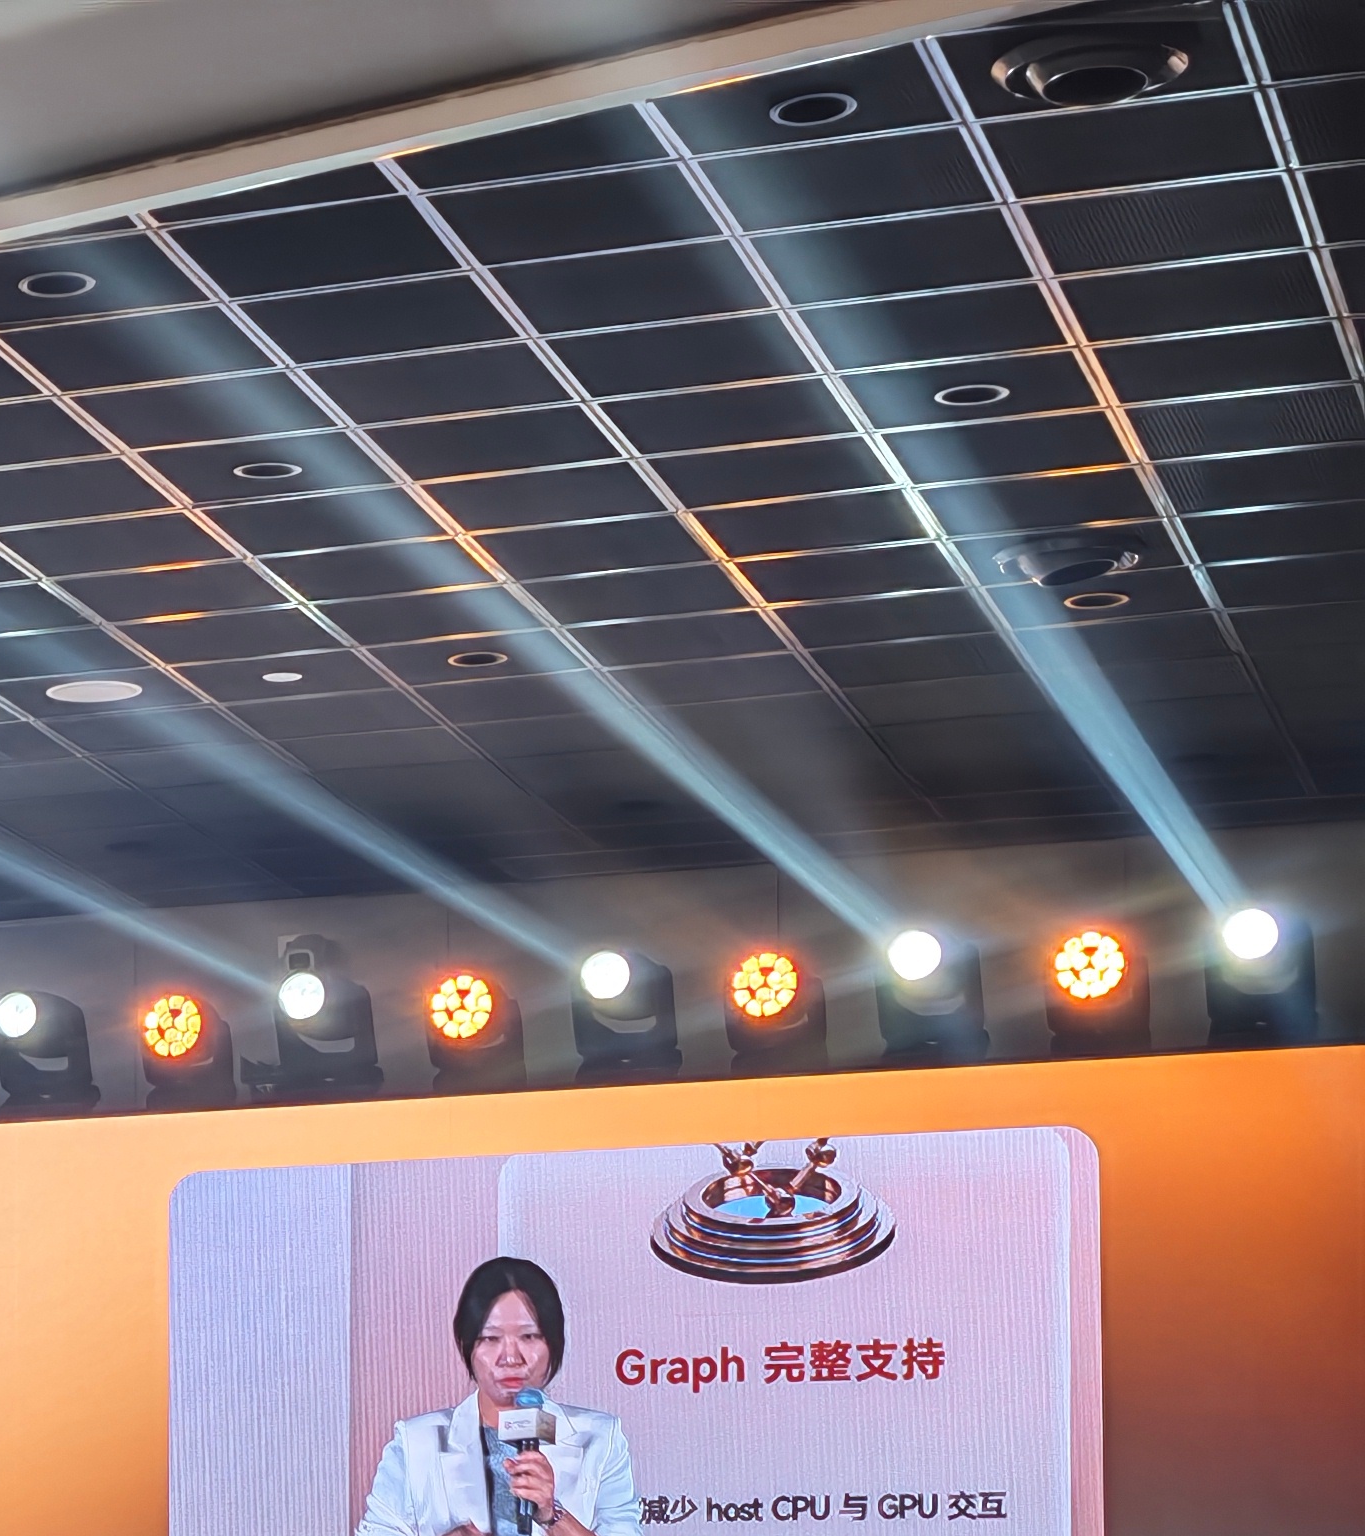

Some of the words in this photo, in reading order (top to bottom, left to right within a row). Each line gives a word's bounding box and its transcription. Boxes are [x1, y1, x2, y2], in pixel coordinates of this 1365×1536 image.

[616, 1347, 745, 1393] Graph
[764, 1337, 945, 1383] 完整支持
[707, 1498, 763, 1522] host
[771, 1496, 830, 1521] CPU
[839, 1494, 868, 1521] 与
[877, 1494, 938, 1520] GPU
[947, 1491, 1007, 1520] 交互
